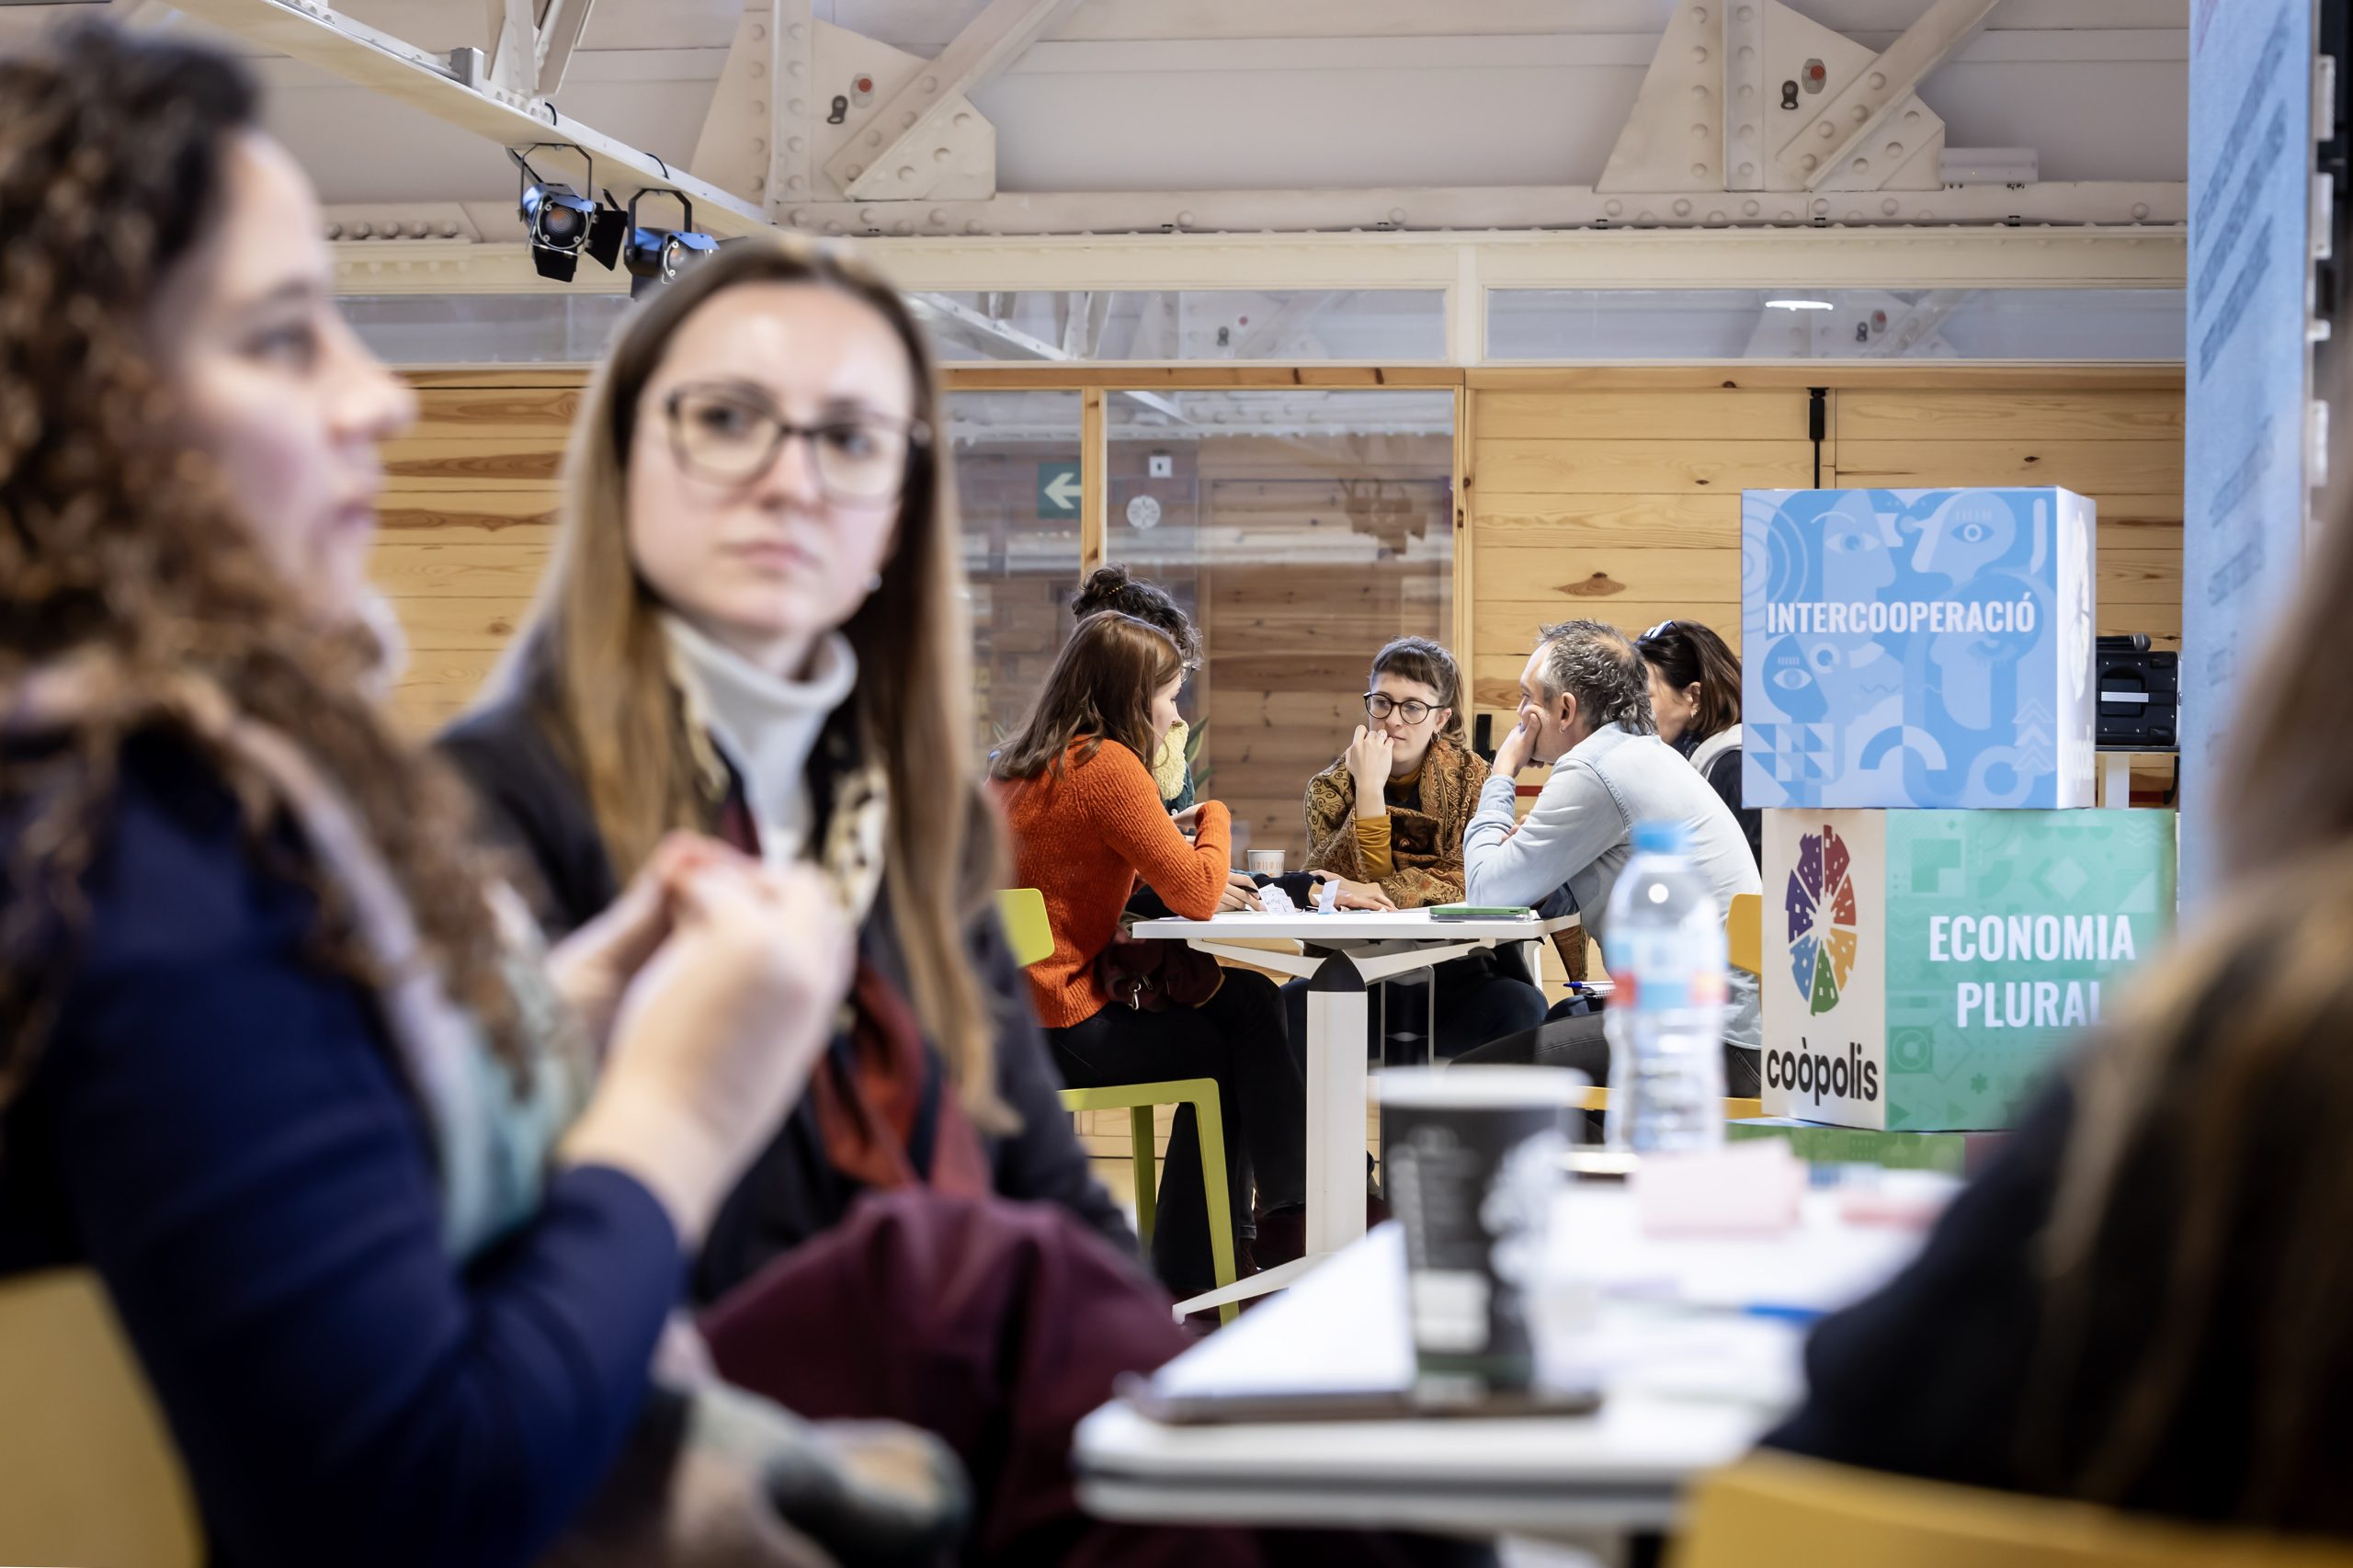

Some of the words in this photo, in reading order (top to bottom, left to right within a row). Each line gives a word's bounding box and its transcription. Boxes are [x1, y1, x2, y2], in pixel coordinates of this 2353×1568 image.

[1767, 592, 2036, 634] INTERCOOPERACIÓ
[1929, 915, 2136, 962] ECONOMIA
[1766, 1037, 1878, 1107] coòpolis
